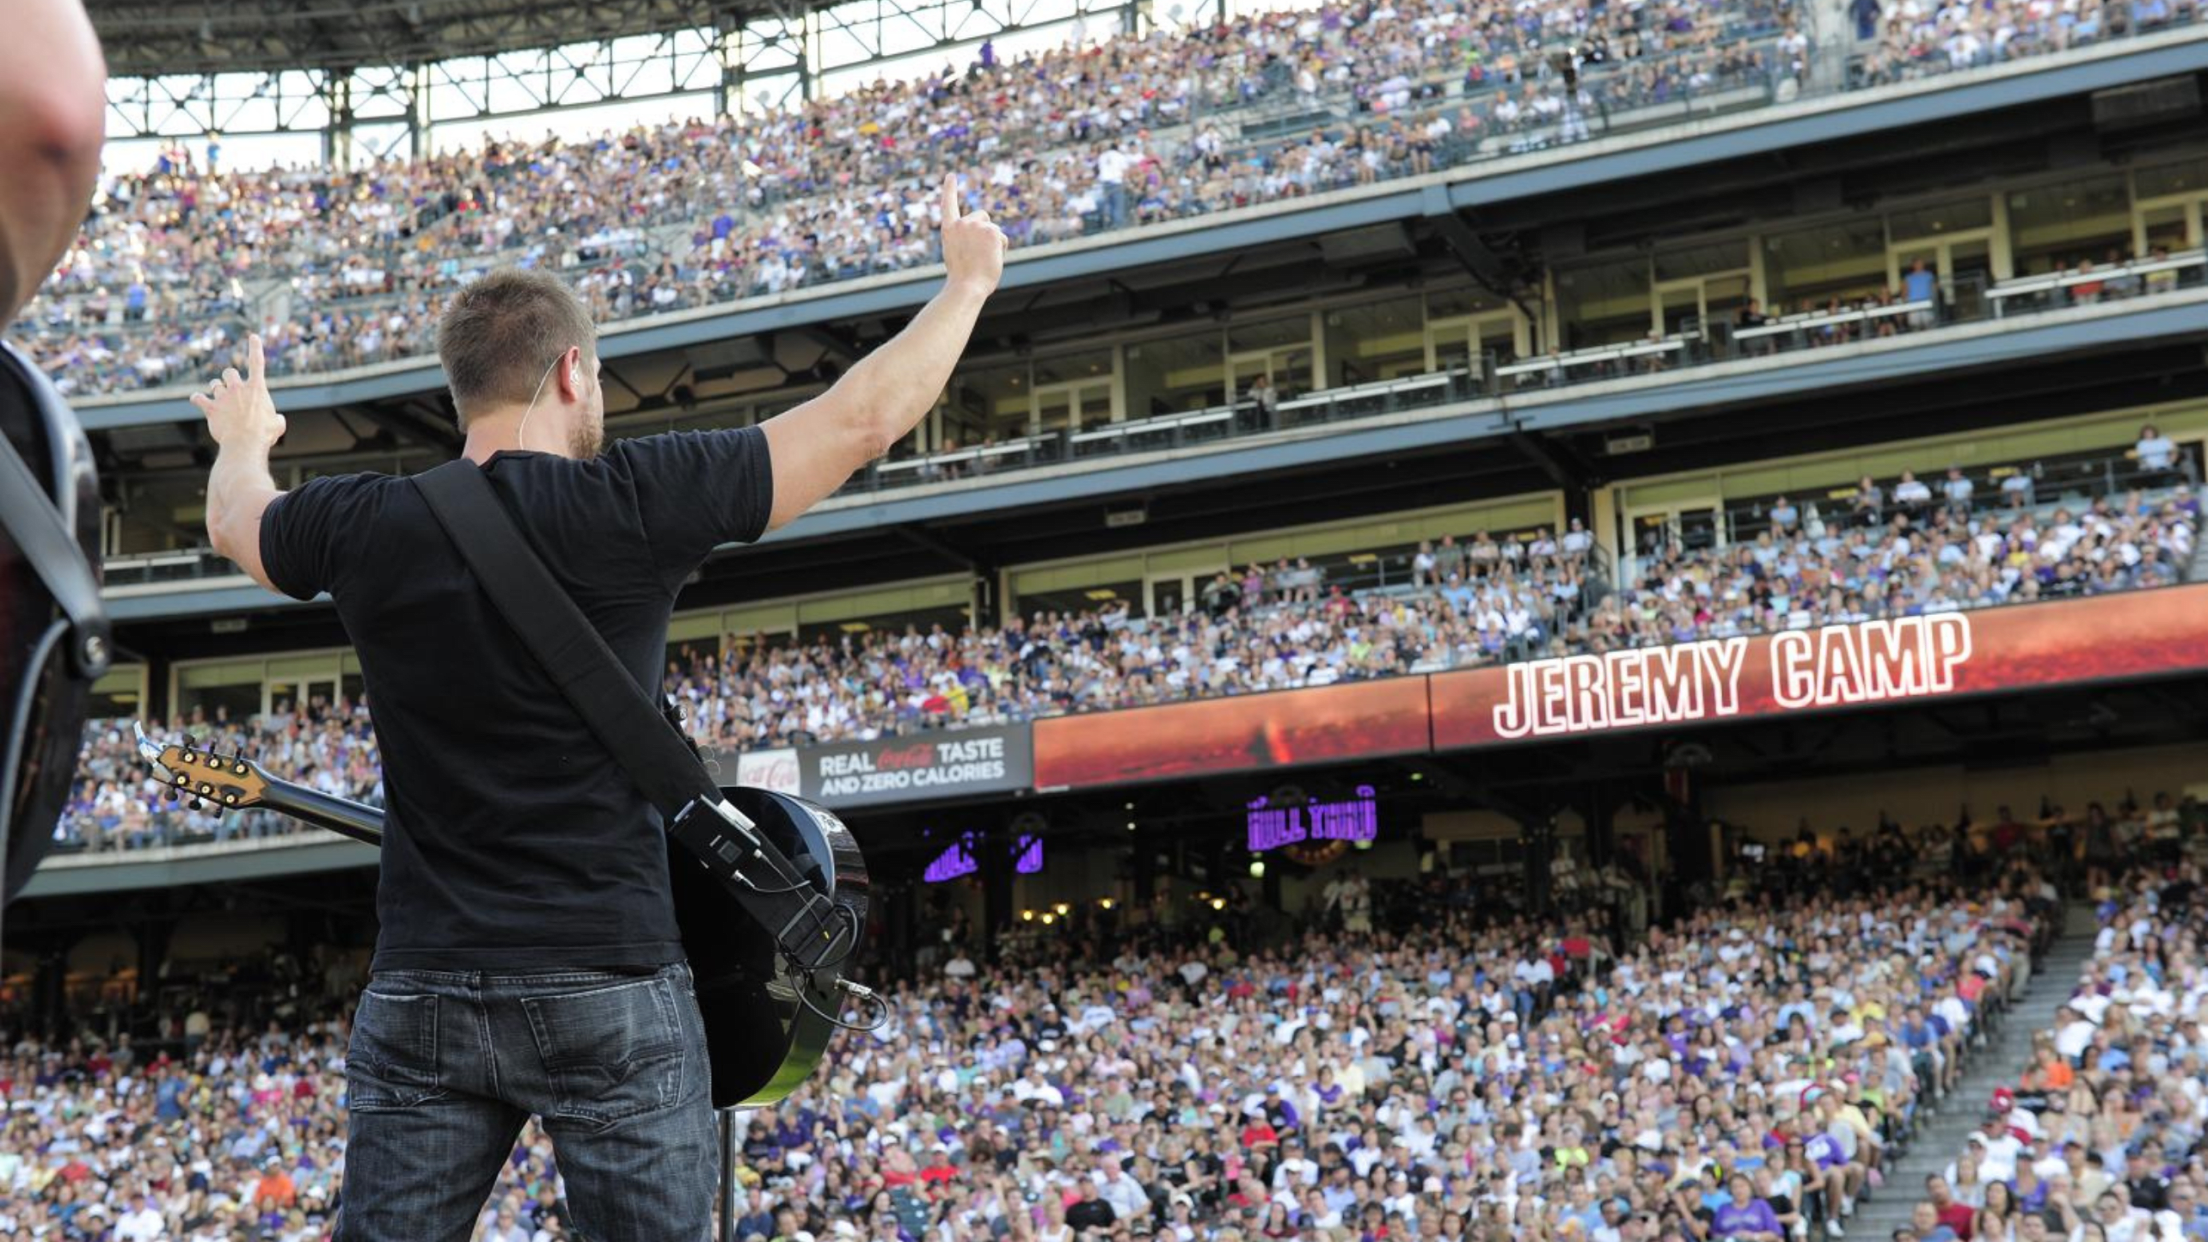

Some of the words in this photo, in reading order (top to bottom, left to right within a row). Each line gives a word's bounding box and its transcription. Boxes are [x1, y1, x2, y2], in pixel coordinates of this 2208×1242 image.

[1493, 636, 1748, 739] JEREMY
[1769, 611, 1973, 709] CAMP
[819, 752, 877, 777] REAL
[937, 737, 1005, 763] TASTE
[820, 774, 861, 797] AND
[862, 768, 909, 793] ZERO
[911, 760, 1006, 788] CALORIES
